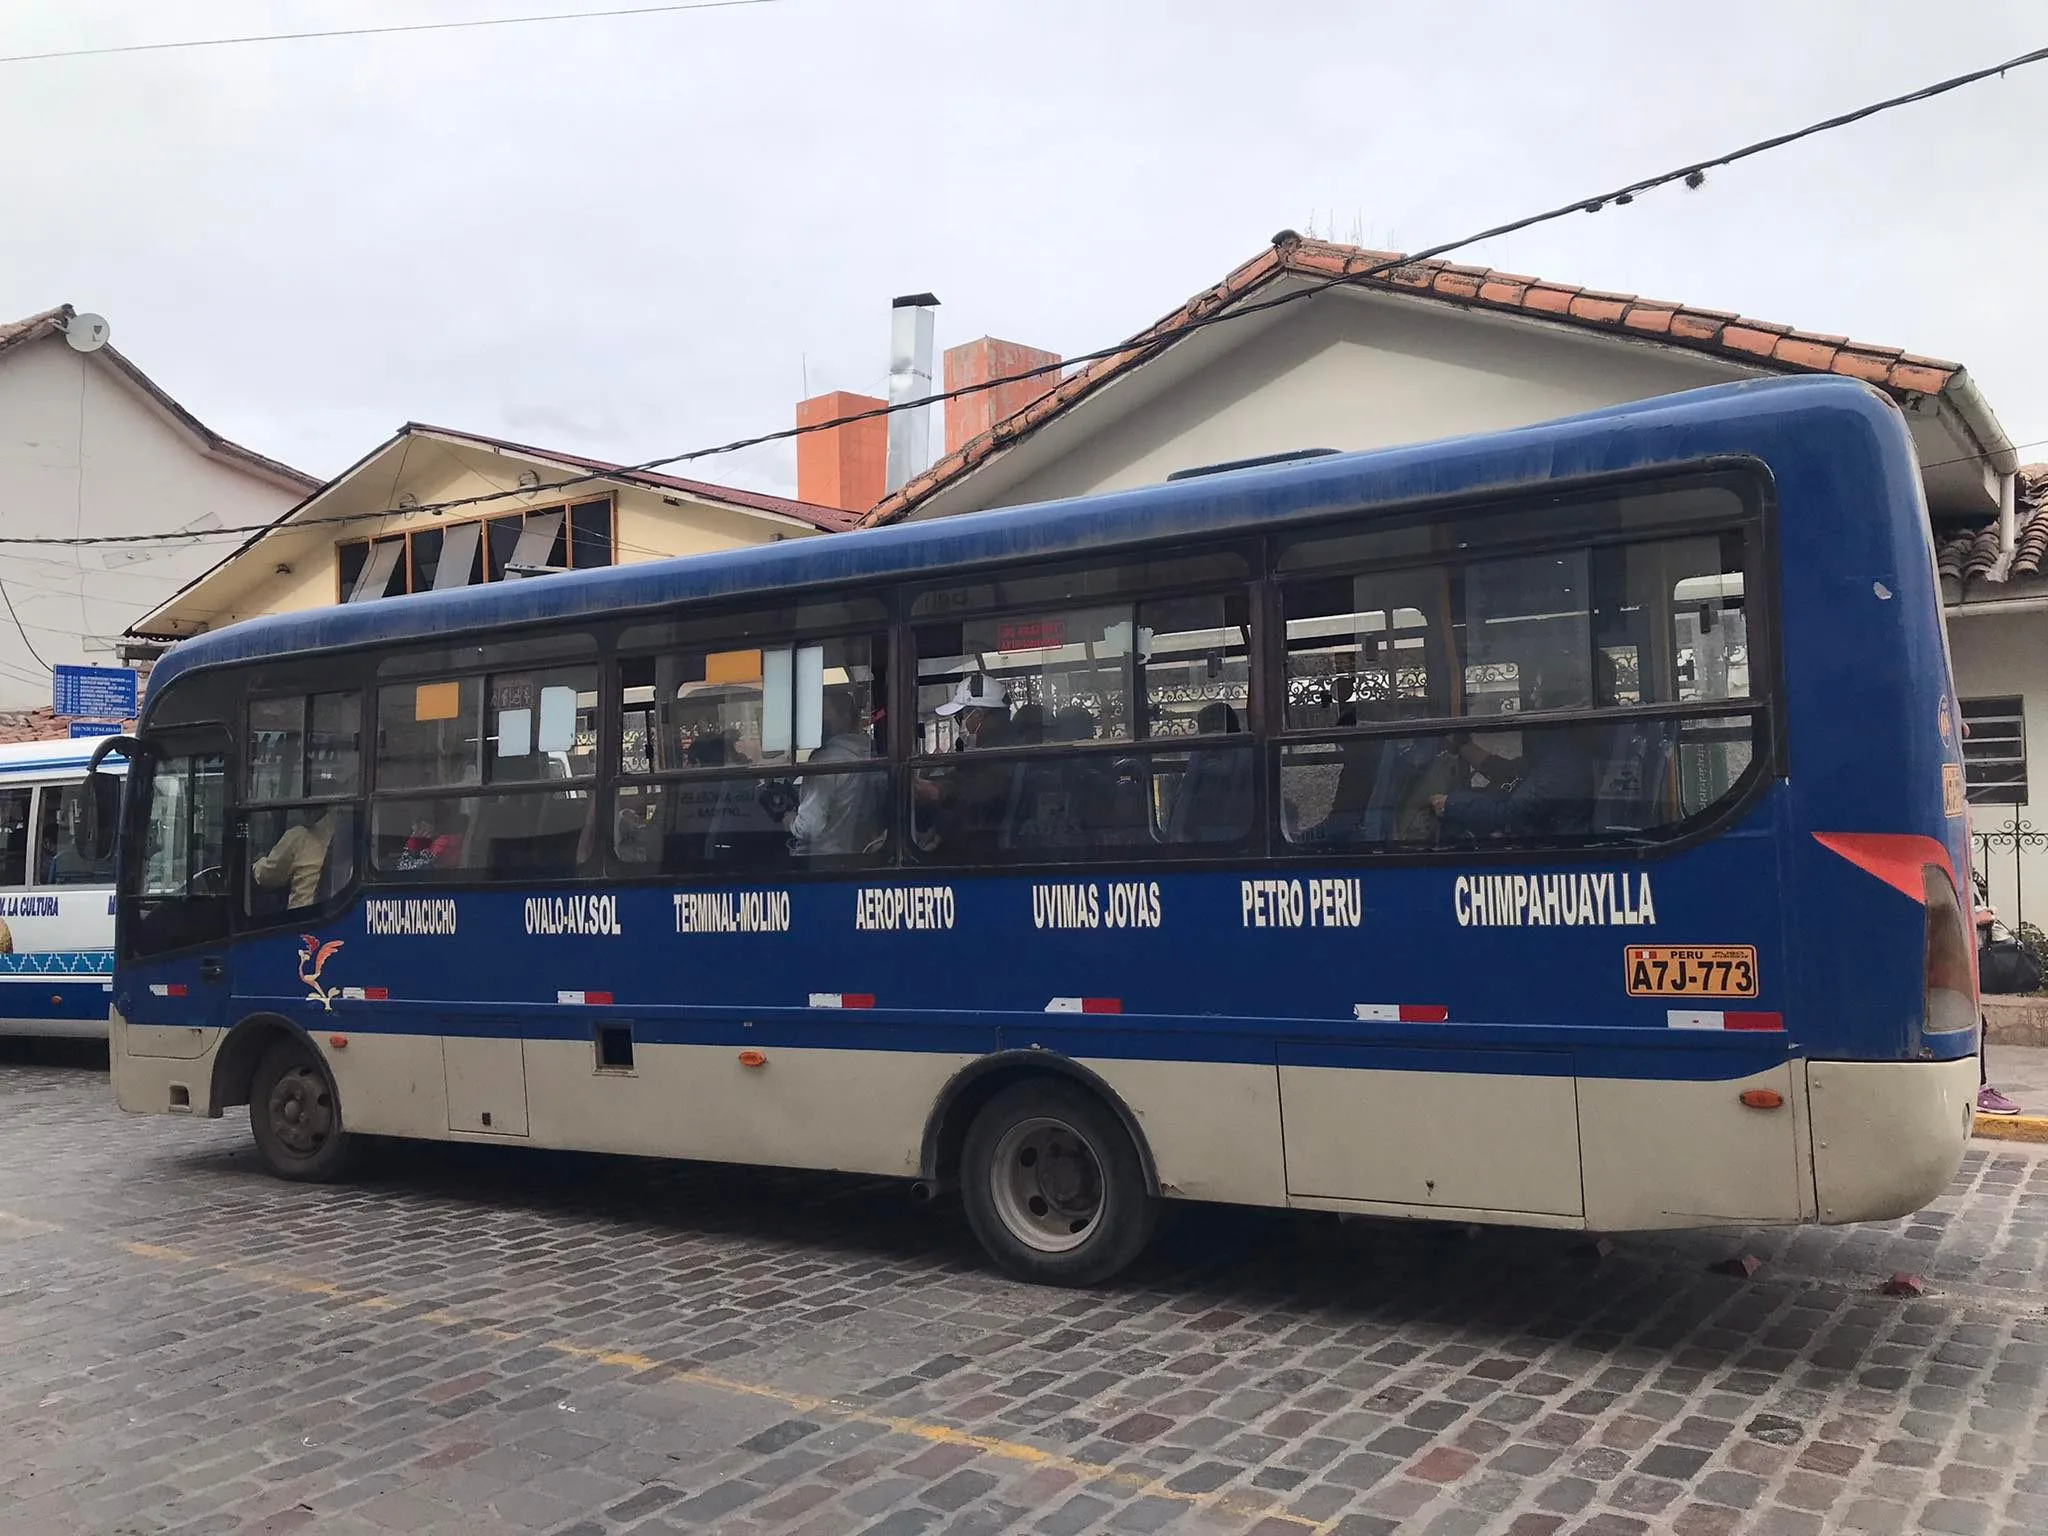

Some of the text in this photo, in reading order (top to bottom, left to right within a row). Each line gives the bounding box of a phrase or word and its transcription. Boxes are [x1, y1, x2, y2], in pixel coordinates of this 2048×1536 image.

[8, 897, 18, 916] LA
[20, 897, 59, 916] CULTURA
[367, 899, 457, 935] PICCHU-AYACUCHO
[525, 895, 621, 935] OVALO-AV.SOL
[674, 891, 790, 932] TERMINAL-MOLINO
[856, 887, 955, 929] AEROPUERTO
[1033, 882, 1161, 928] UVIMAS JOYAS
[1242, 879, 1361, 927] PETRO PERU
[1455, 873, 1656, 926] CHIMPAHUAYLLA
[1670, 951, 1704, 960] PERU
[1631, 961, 1753, 992] A7J-773
